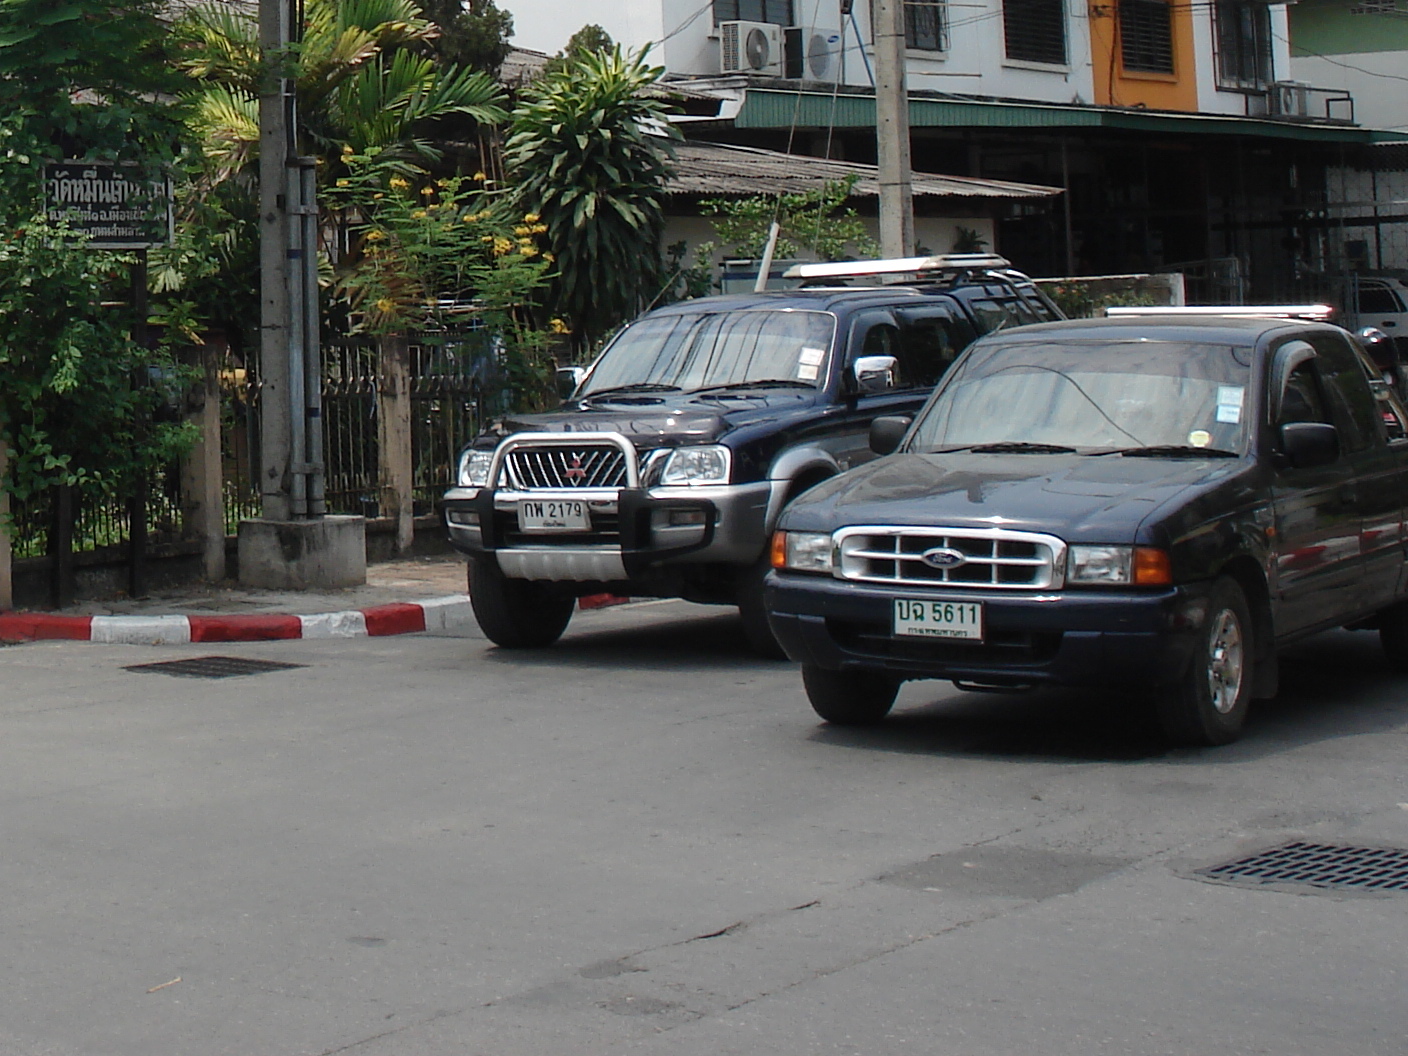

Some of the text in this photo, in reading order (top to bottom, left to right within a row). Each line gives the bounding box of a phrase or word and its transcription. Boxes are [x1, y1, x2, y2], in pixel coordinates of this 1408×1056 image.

[548, 502, 582, 518] 2179
[897, 600, 977, 625] ปฉ 5611
